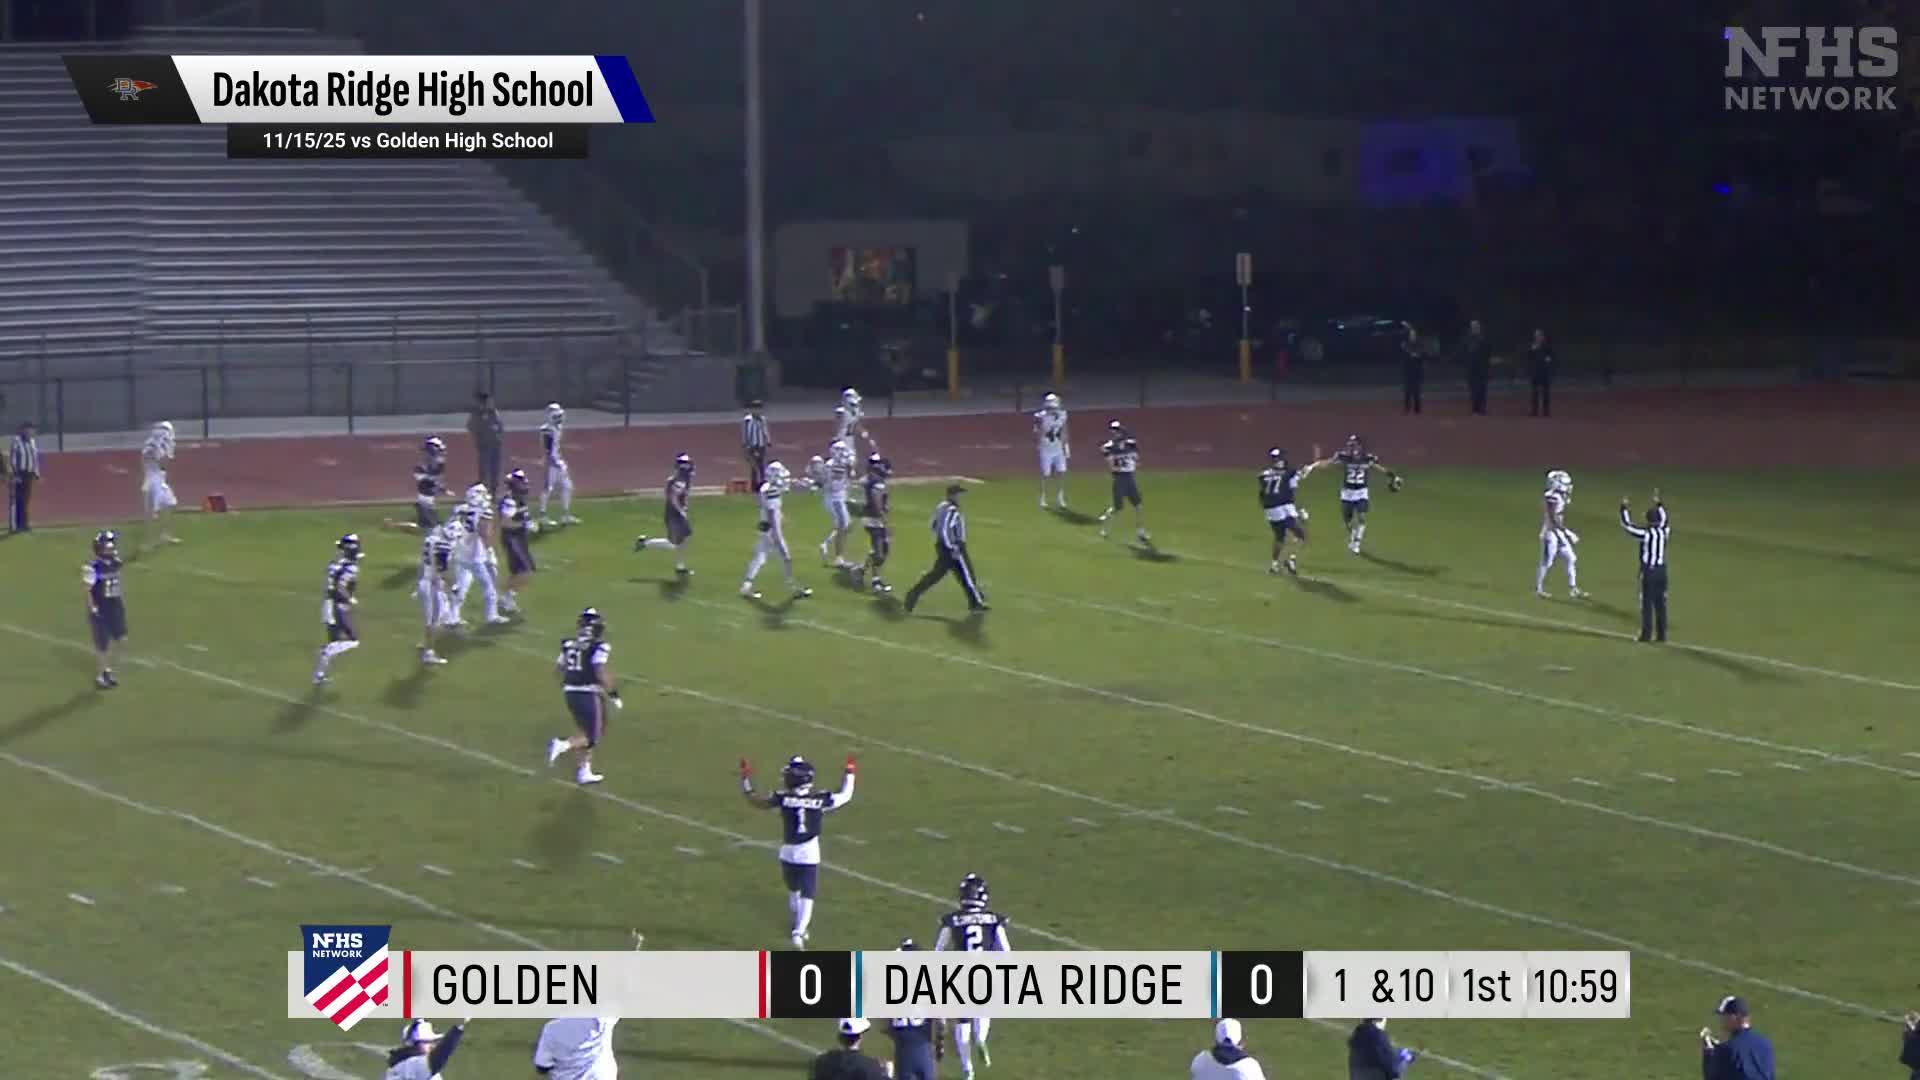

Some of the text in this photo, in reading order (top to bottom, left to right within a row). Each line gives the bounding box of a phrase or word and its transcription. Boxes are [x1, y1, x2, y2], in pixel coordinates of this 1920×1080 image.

[1263, 475, 1282, 495] 77
[1345, 468, 1366, 485] 22
[567, 649, 583, 671] 51
[797, 808, 806, 833] 1
[966, 925, 984, 951] 2
